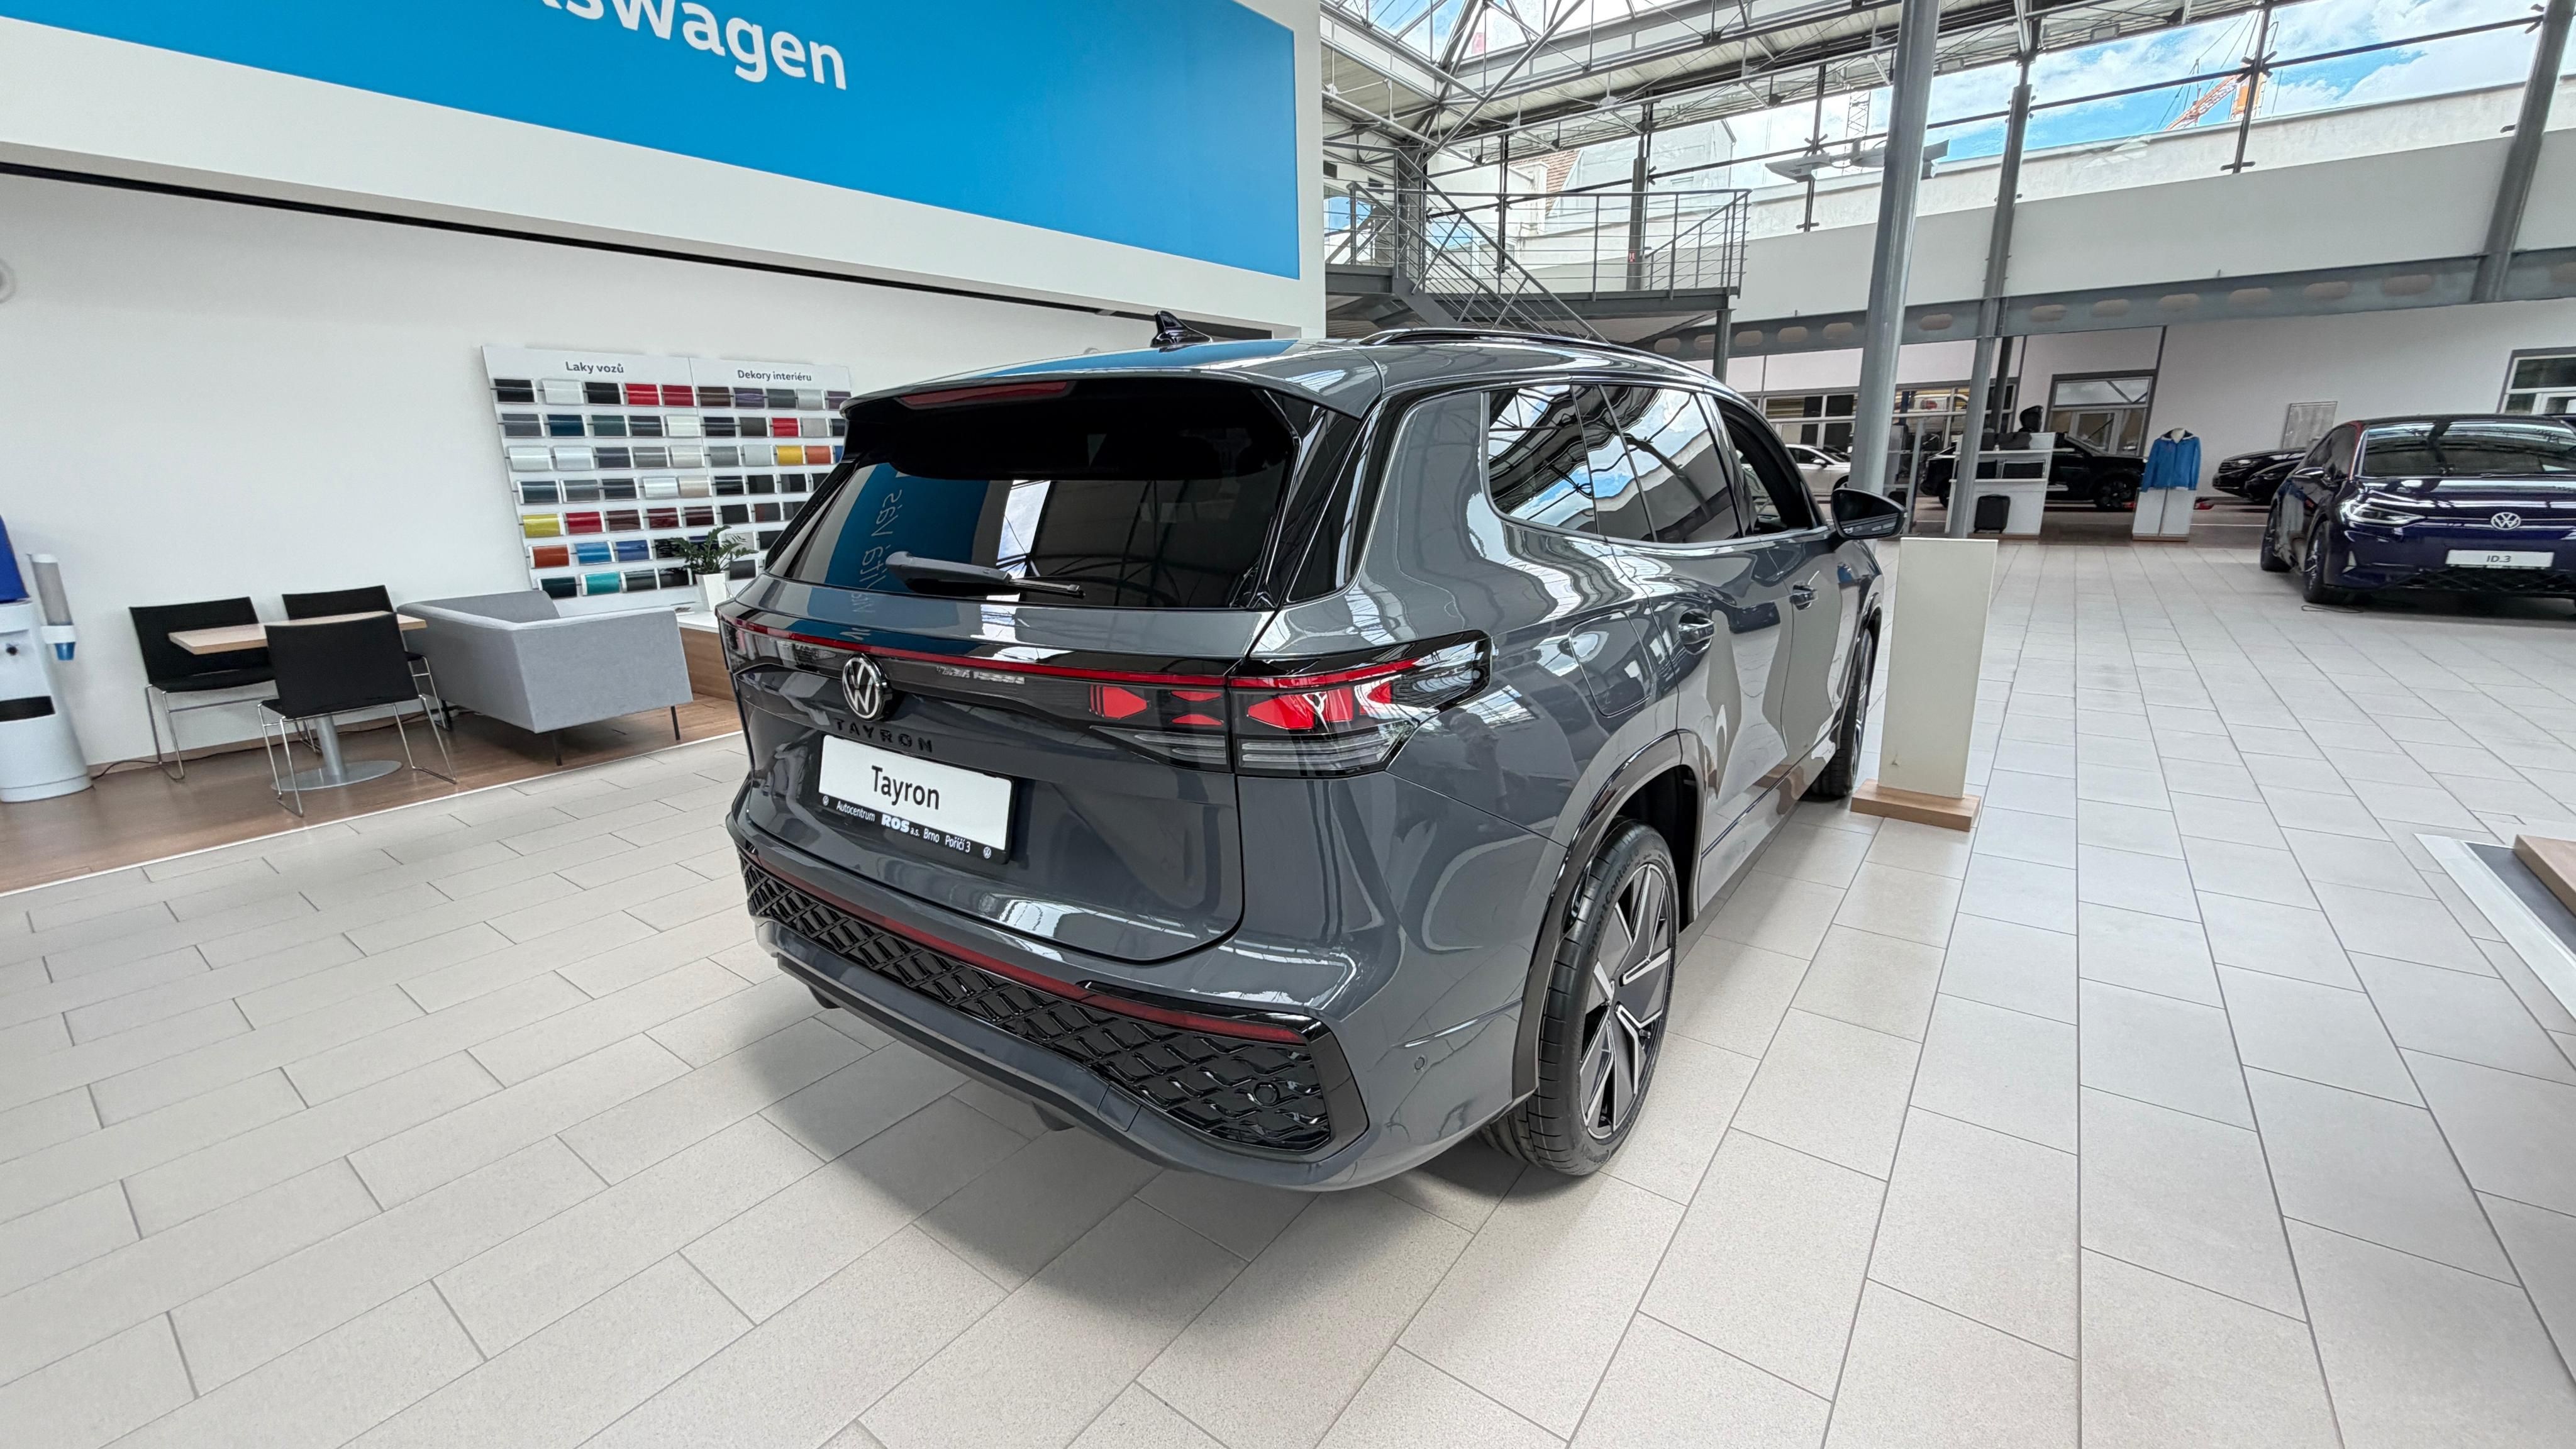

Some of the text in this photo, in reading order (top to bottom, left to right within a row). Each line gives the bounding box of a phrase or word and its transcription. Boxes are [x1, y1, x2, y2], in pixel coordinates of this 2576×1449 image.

[541, 0, 847, 91] wagen
[565, 362, 625, 374] Laky vozů
[737, 369, 812, 382] Dekory interiéru
[834, 718, 933, 753] TAYRON
[872, 765, 940, 810] Tayron
[836, 800, 876, 822] Autocentrum
[881, 814, 910, 833] ROS
[923, 828, 940, 843] Brno
[965, 841, 971, 853] 3
